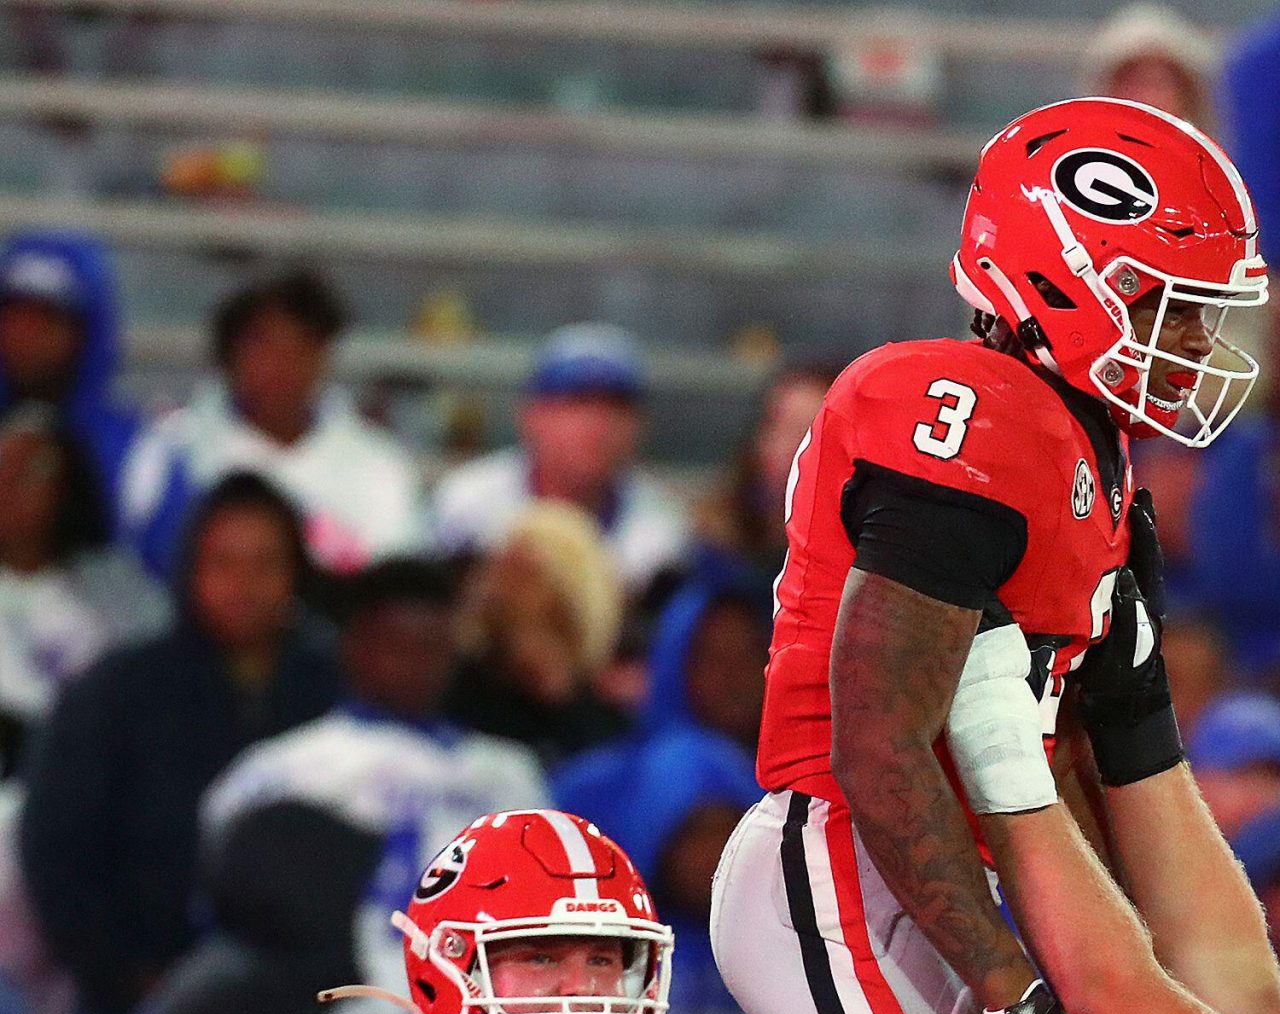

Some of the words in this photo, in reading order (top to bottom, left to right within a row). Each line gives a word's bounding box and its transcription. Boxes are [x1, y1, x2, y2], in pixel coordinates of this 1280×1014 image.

[911, 376, 978, 460] 3
[1074, 462, 1094, 515] SEC
[566, 902, 617, 912] DAWGS
